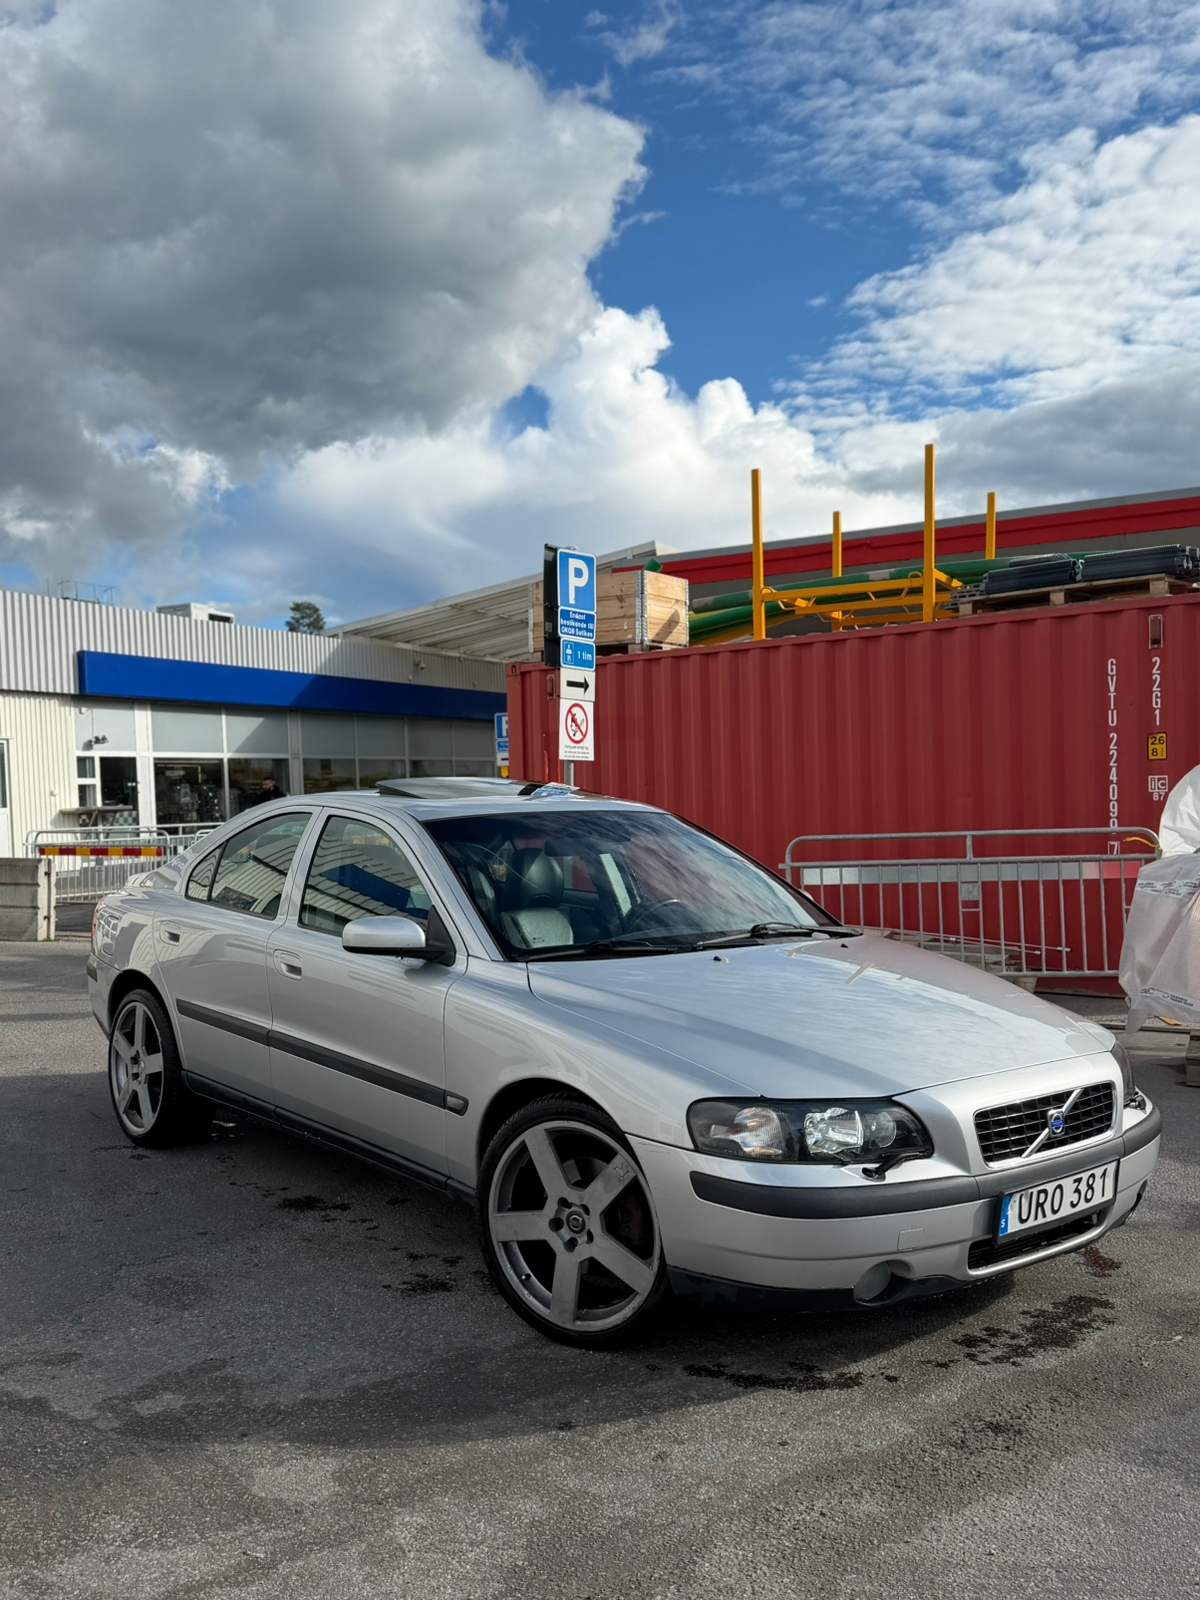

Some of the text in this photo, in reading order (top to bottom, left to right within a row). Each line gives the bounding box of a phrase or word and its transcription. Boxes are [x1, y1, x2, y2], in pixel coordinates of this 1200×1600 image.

[568, 557, 589, 605] P
[569, 611, 586, 620] Endast
[560, 617, 587, 628] besökande
[577, 650, 593, 661] 1 tim
[1107, 658, 1117, 727] GVTU
[1152, 656, 1161, 727] 22G1
[1152, 792, 1165, 801] 87
[1018, 1167, 1108, 1224] URO 381
[1000, 1219, 1006, 1228] S
